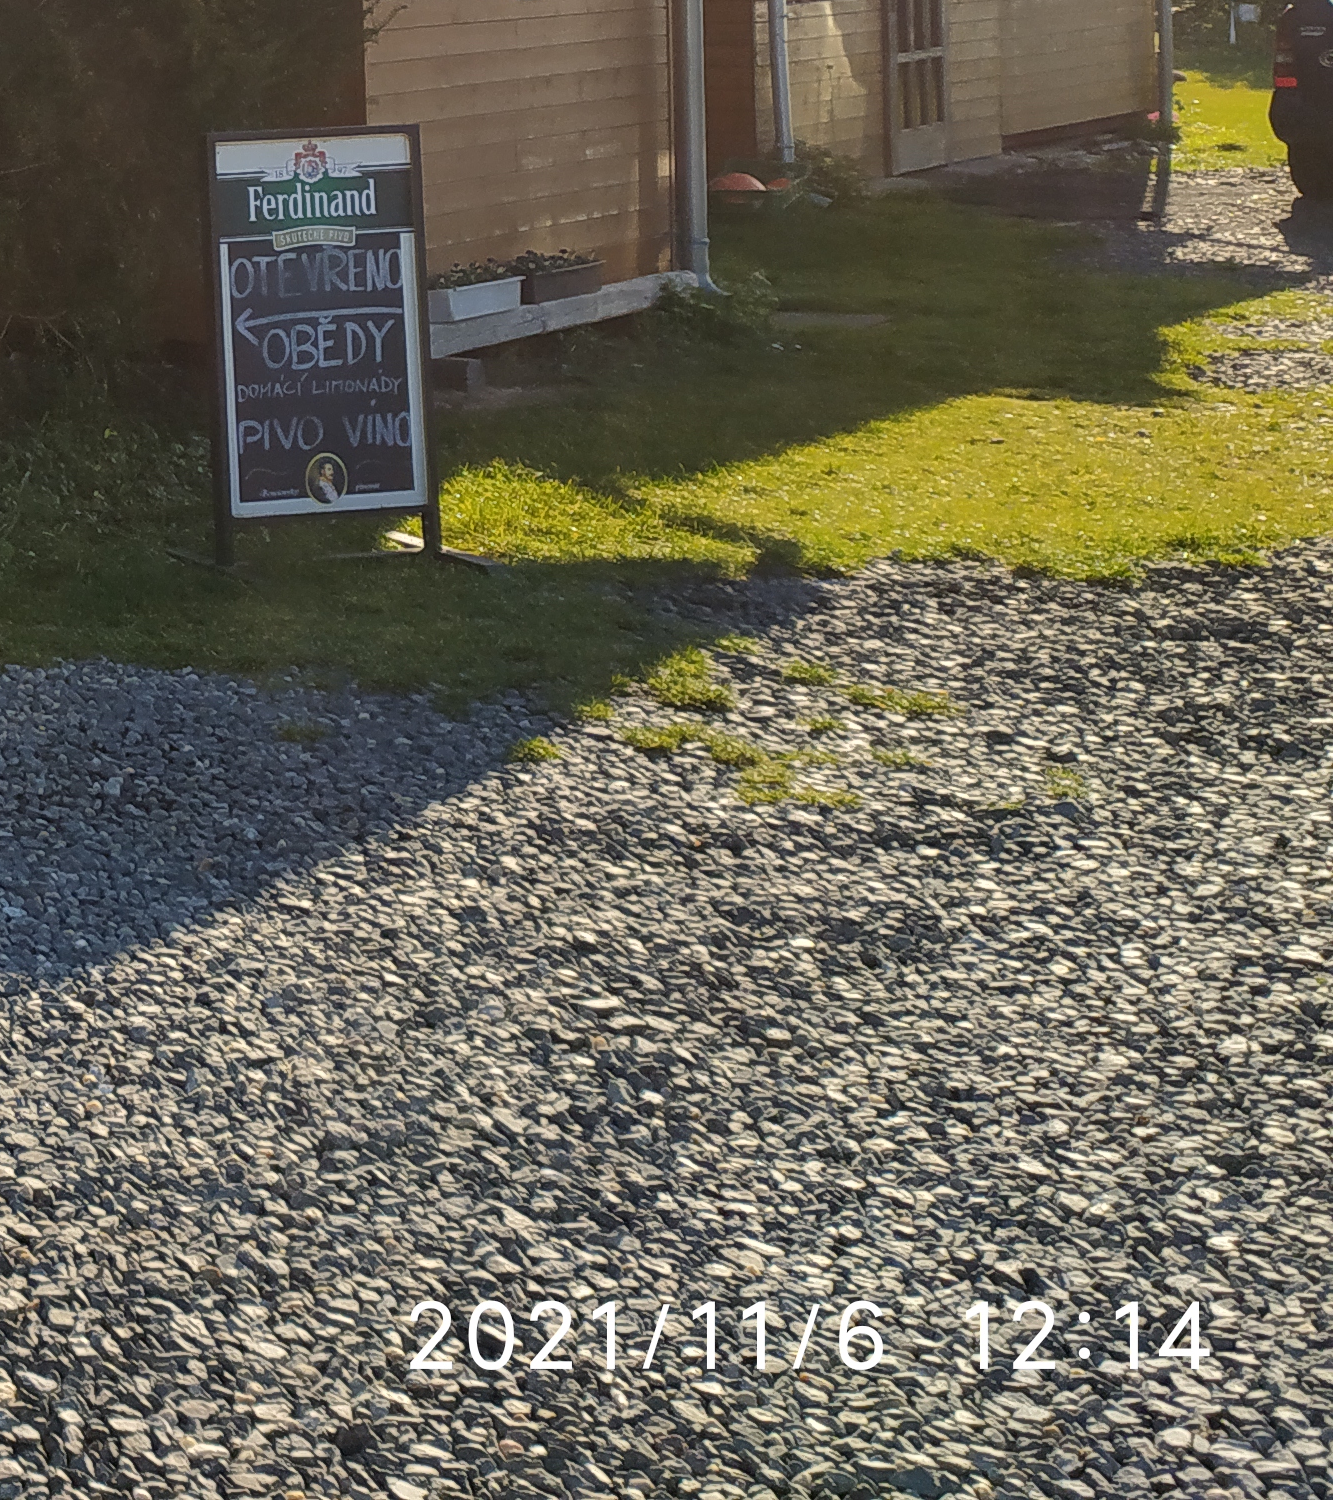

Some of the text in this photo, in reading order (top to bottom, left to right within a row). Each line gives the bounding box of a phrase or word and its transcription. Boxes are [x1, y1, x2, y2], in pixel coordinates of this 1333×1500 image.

[274, 167, 348, 179] 18 97
[247, 178, 377, 222] Ferdinand
[329, 230, 351, 242] PIVO
[230, 245, 403, 299] OTEVŘENO
[263, 314, 395, 370] OBĚDY
[237, 369, 403, 403] DOMÁCÍ LIMONÁDY
[238, 415, 324, 455] PIVO
